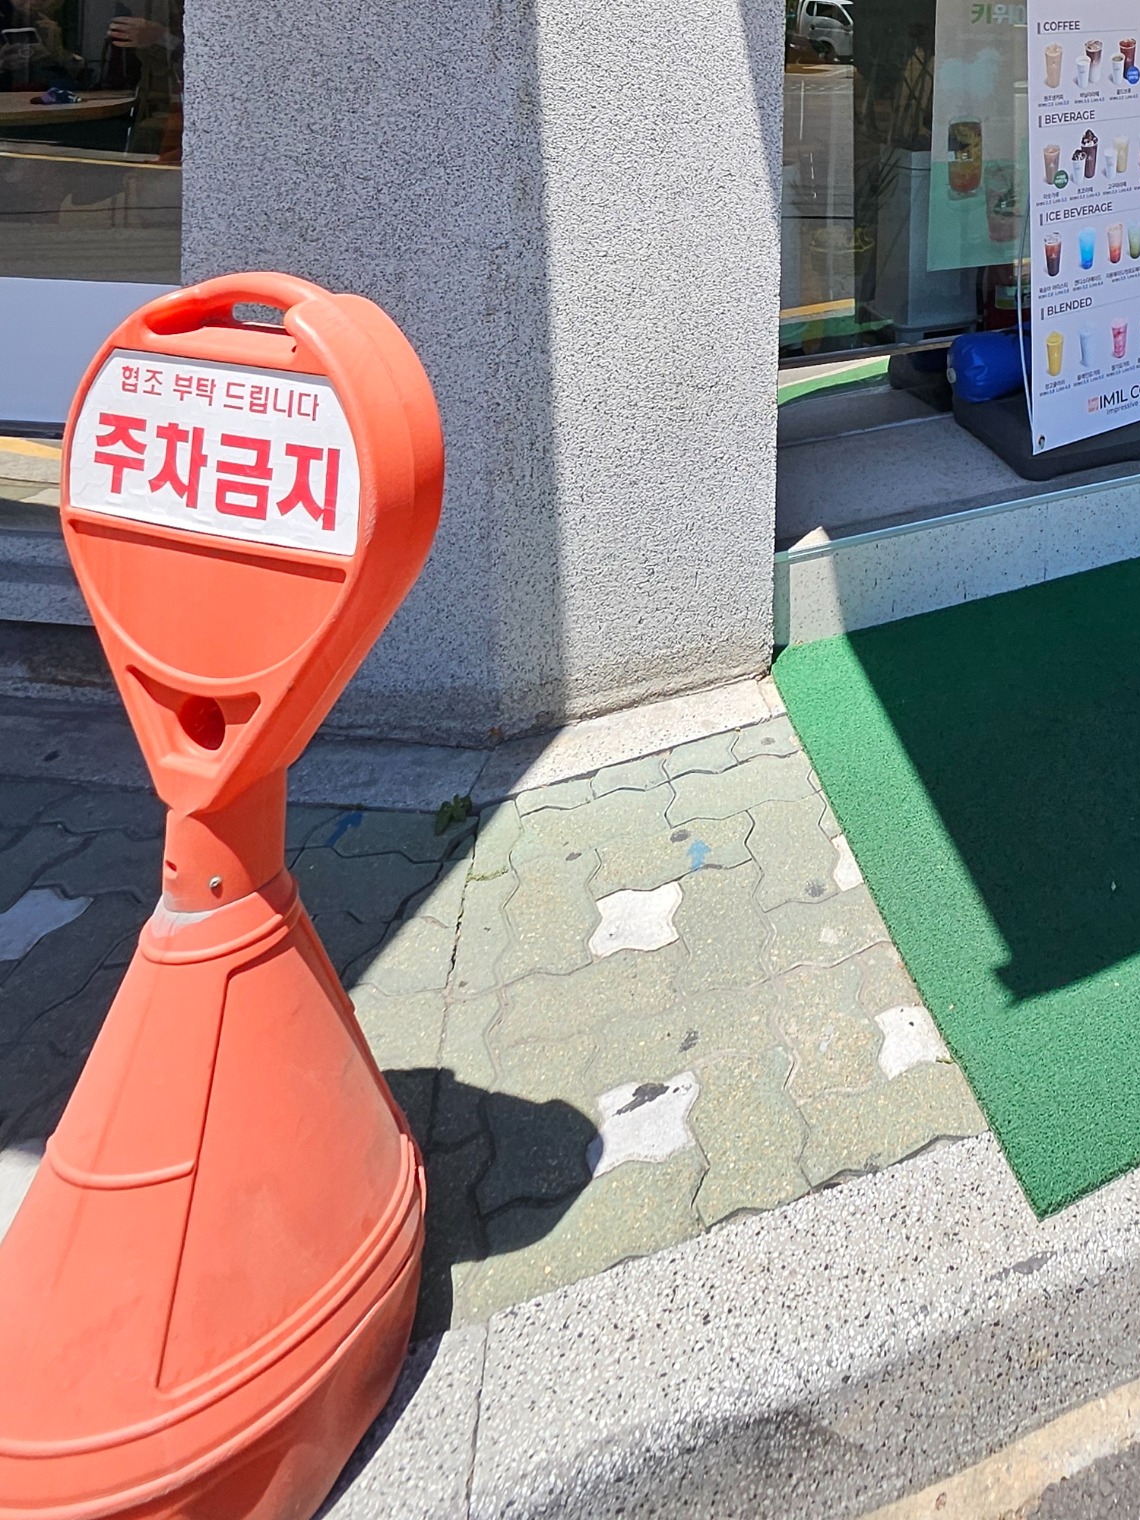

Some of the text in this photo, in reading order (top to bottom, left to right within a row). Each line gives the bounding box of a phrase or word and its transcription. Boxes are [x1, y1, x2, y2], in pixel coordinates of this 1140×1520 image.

[1043, 20, 1081, 31] COFFEE
[1044, 110, 1096, 125] BEVERAGE
[1045, 202, 1113, 223] ICE BEVERAGE
[1047, 296, 1093, 316] BLENDED
[121, 364, 320, 422] 협조 부탁 드립니다
[93, 411, 341, 532] 주차금지
